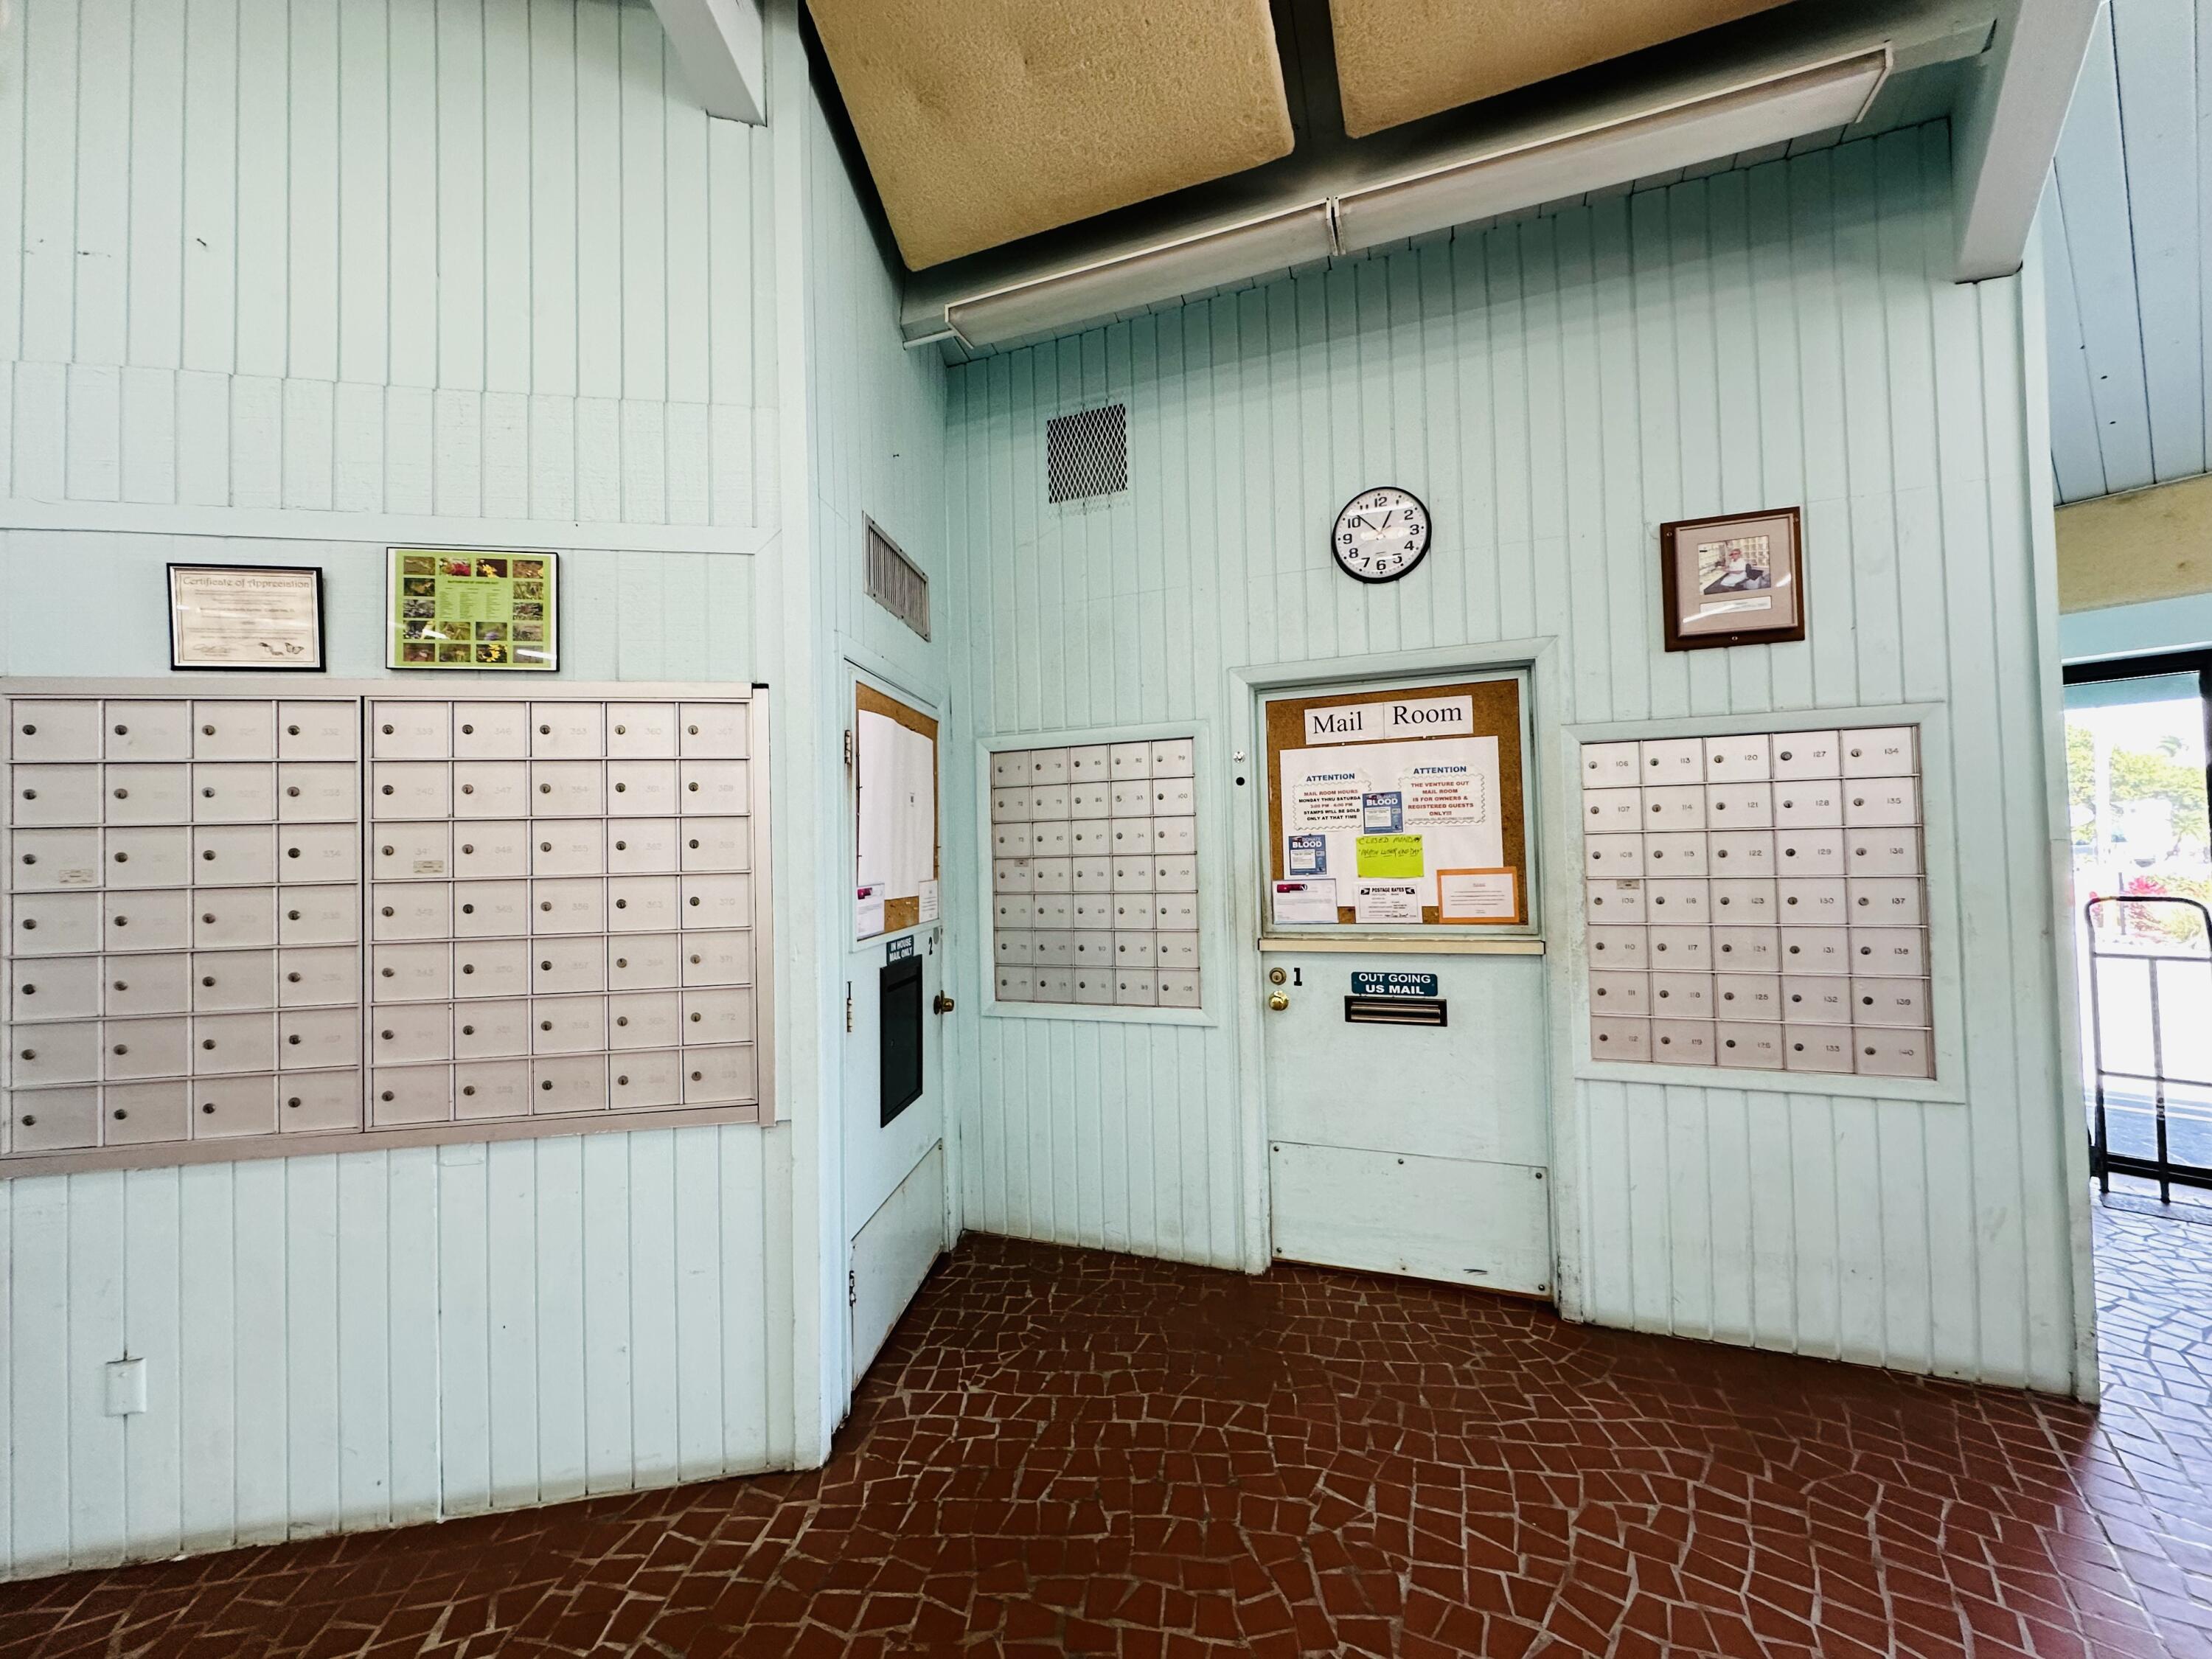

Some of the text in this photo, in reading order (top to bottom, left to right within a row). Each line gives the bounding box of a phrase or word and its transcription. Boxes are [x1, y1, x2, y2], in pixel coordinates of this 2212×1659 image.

[1374, 497, 1388, 507] 12
[1404, 509, 1413, 520] 2
[1347, 517, 1361, 528] 10
[1410, 524, 1419, 535] 3
[1343, 534, 1352, 544] 9
[1404, 540, 1414, 551] 4
[1349, 548, 1358, 558] 8
[1393, 553, 1402, 563] 5
[1362, 557, 1370, 568] 7
[1377, 560, 1386, 570] 6
[183, 576, 310, 588] Certificate of Appreciation
[1312, 705, 1462, 734] Mail Room
[1413, 766, 1467, 774] ATTENTION
[1306, 773, 1355, 782] ATTENTION
[1366, 798, 1398, 806] BLOOD
[1358, 836, 1389, 844] CLOSED
[415, 848, 431, 856] 34
[897, 937, 911, 950] HOUSE
[928, 936, 933, 956] 2
[1293, 967, 1302, 987] 1
[1358, 973, 1430, 984] OUT GOING
[1366, 984, 1425, 995] US MAIL
